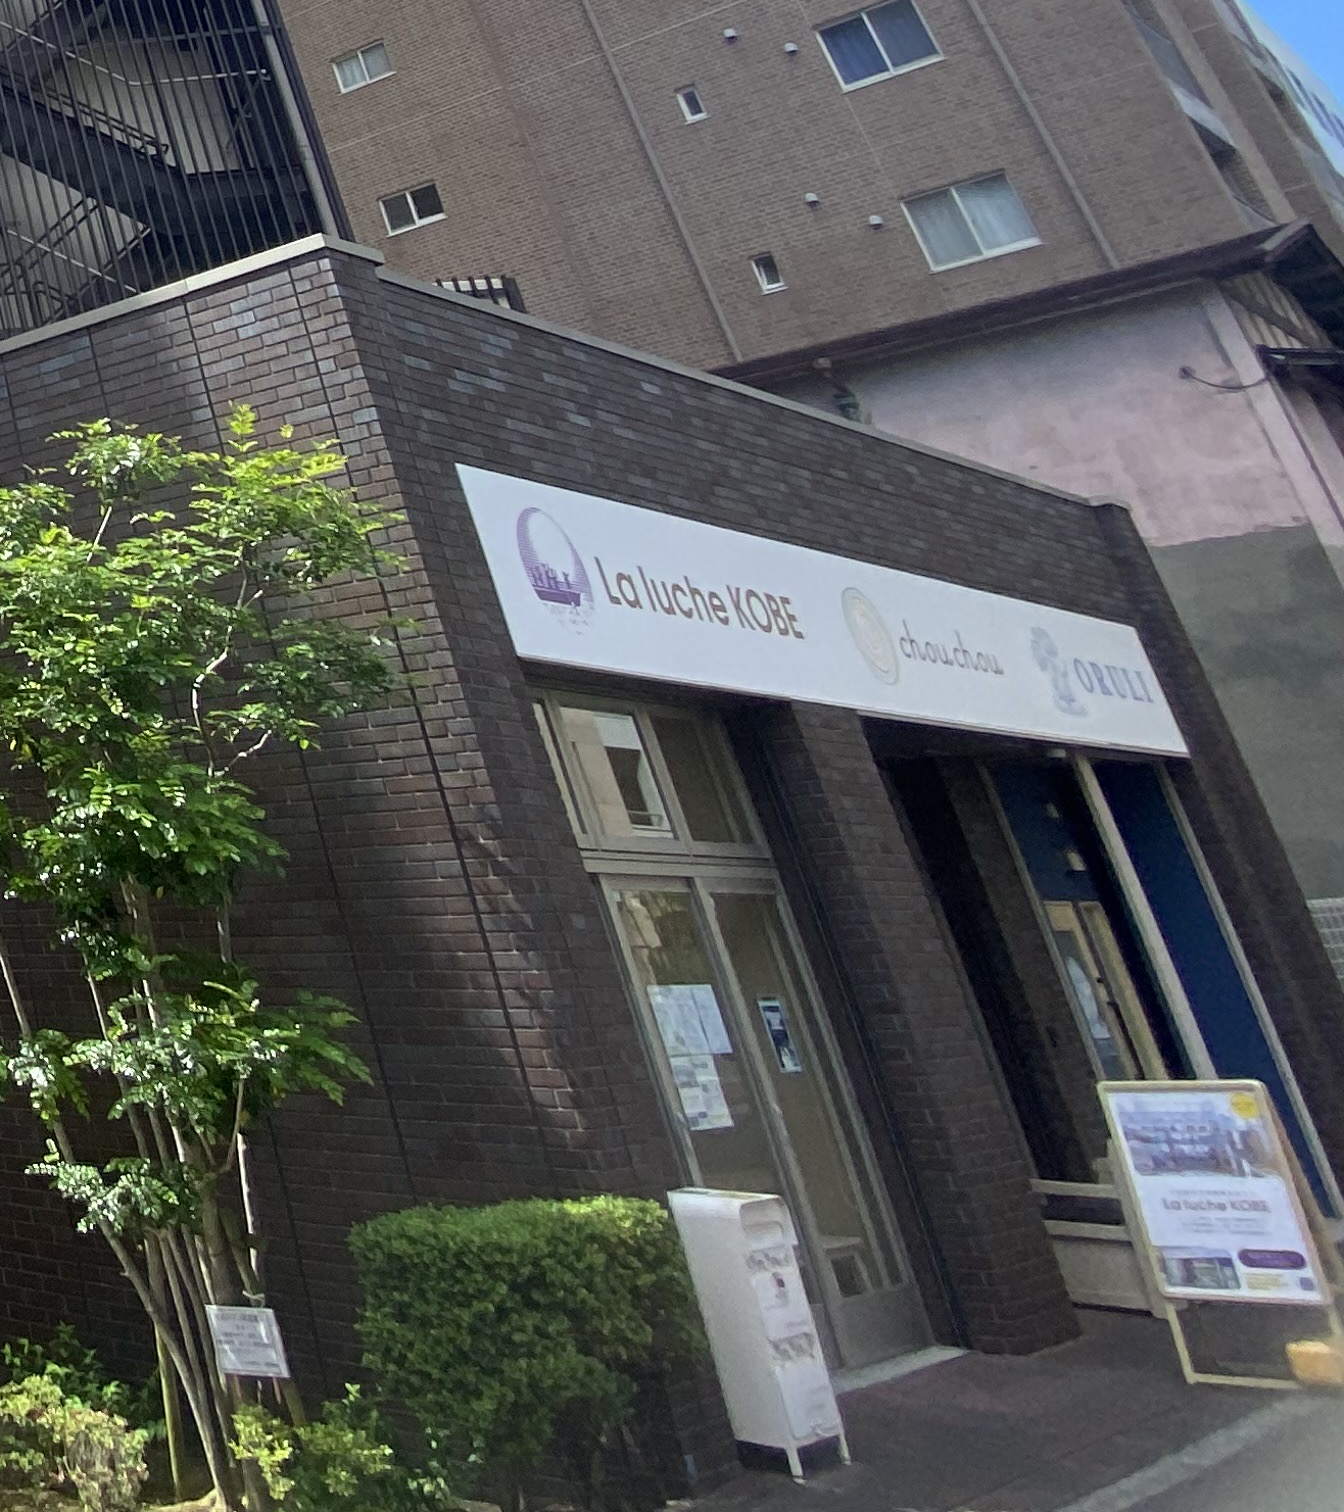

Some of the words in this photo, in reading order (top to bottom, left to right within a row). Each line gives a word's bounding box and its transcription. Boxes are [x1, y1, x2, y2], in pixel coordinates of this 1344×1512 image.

[593, 555, 643, 610] La
[636, 564, 730, 626] luche
[725, 583, 806, 640] KOBE
